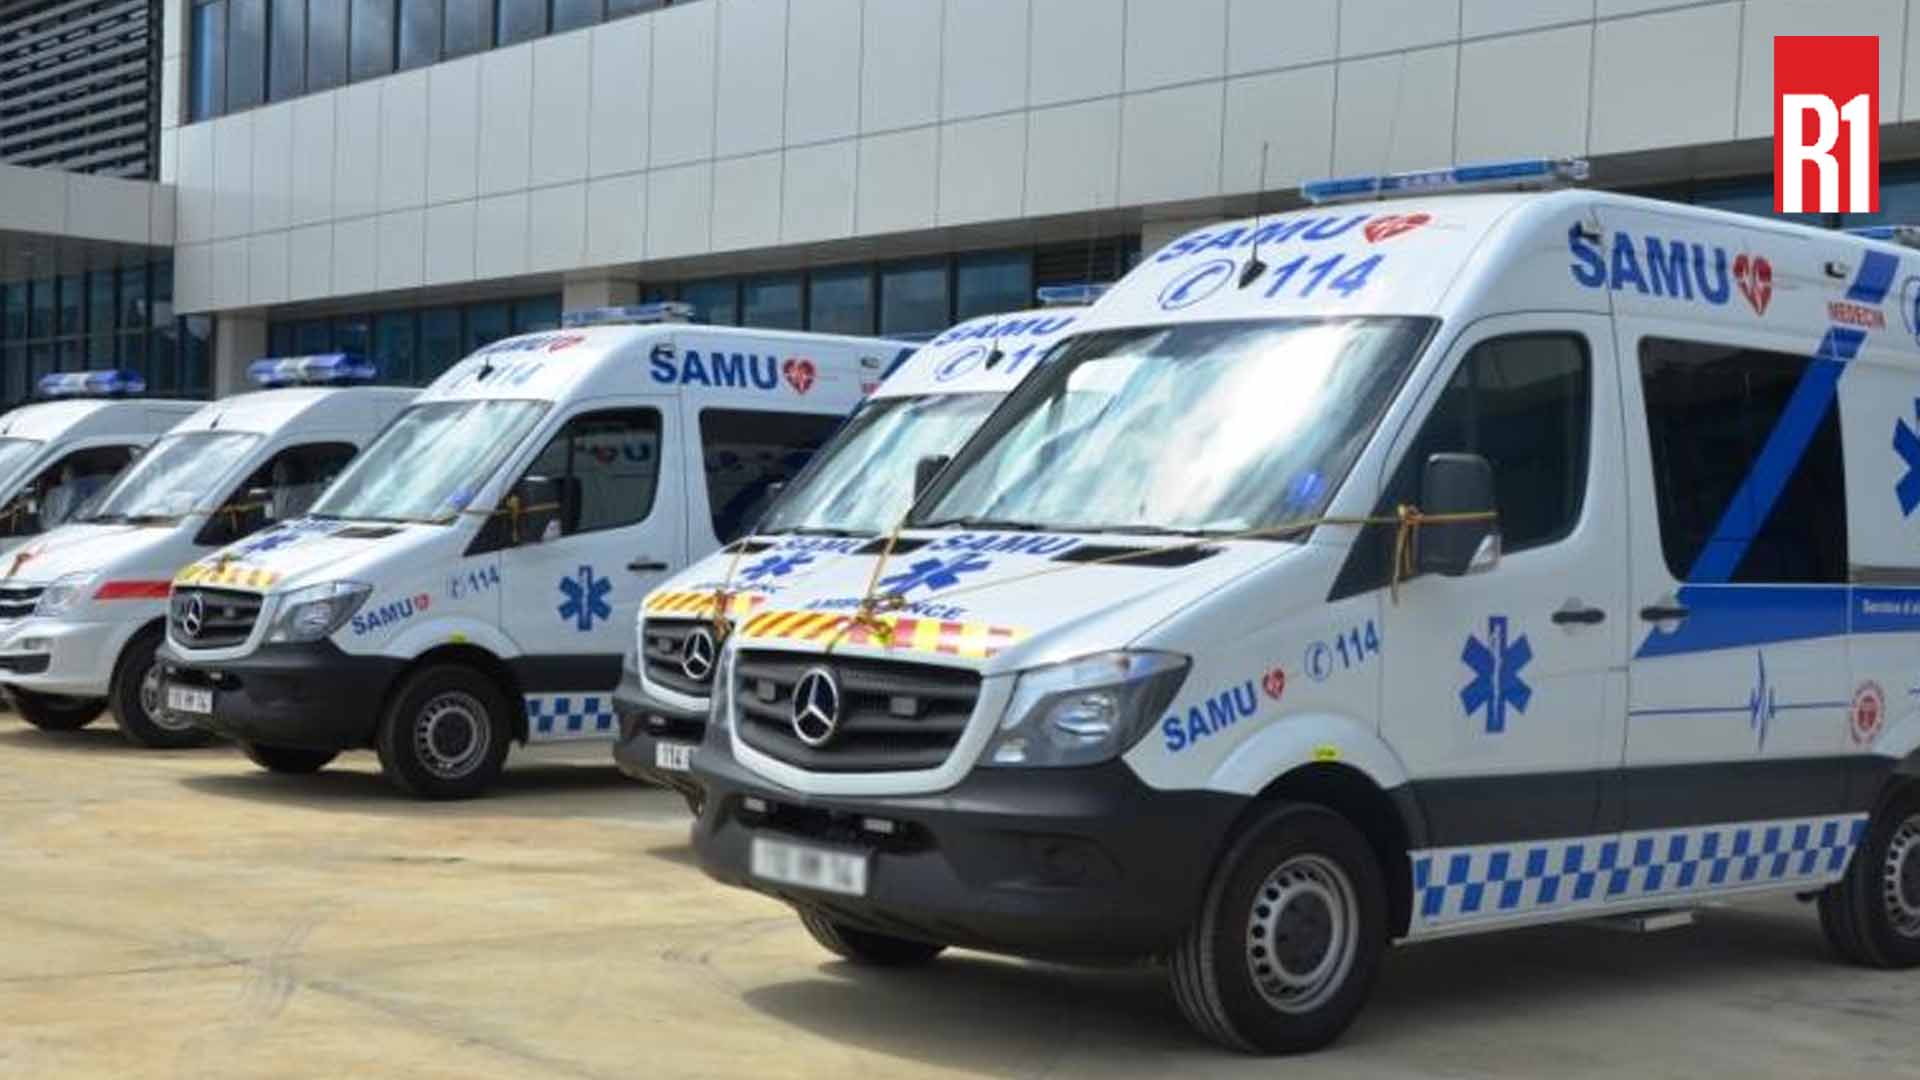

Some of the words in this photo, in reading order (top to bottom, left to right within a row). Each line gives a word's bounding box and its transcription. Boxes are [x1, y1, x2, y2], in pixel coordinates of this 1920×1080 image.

[1156, 214, 1371, 263] SAMU
[1263, 254, 1387, 299] 114
[1567, 221, 1731, 306] SAMU
[933, 316, 1077, 347] SAMU
[649, 345, 779, 390] SAMU
[924, 534, 1081, 554] SAMU
[467, 565, 500, 594] 114
[351, 597, 413, 636] SAMU
[1336, 619, 1380, 669] 114
[1161, 679, 1259, 753] SAMU
